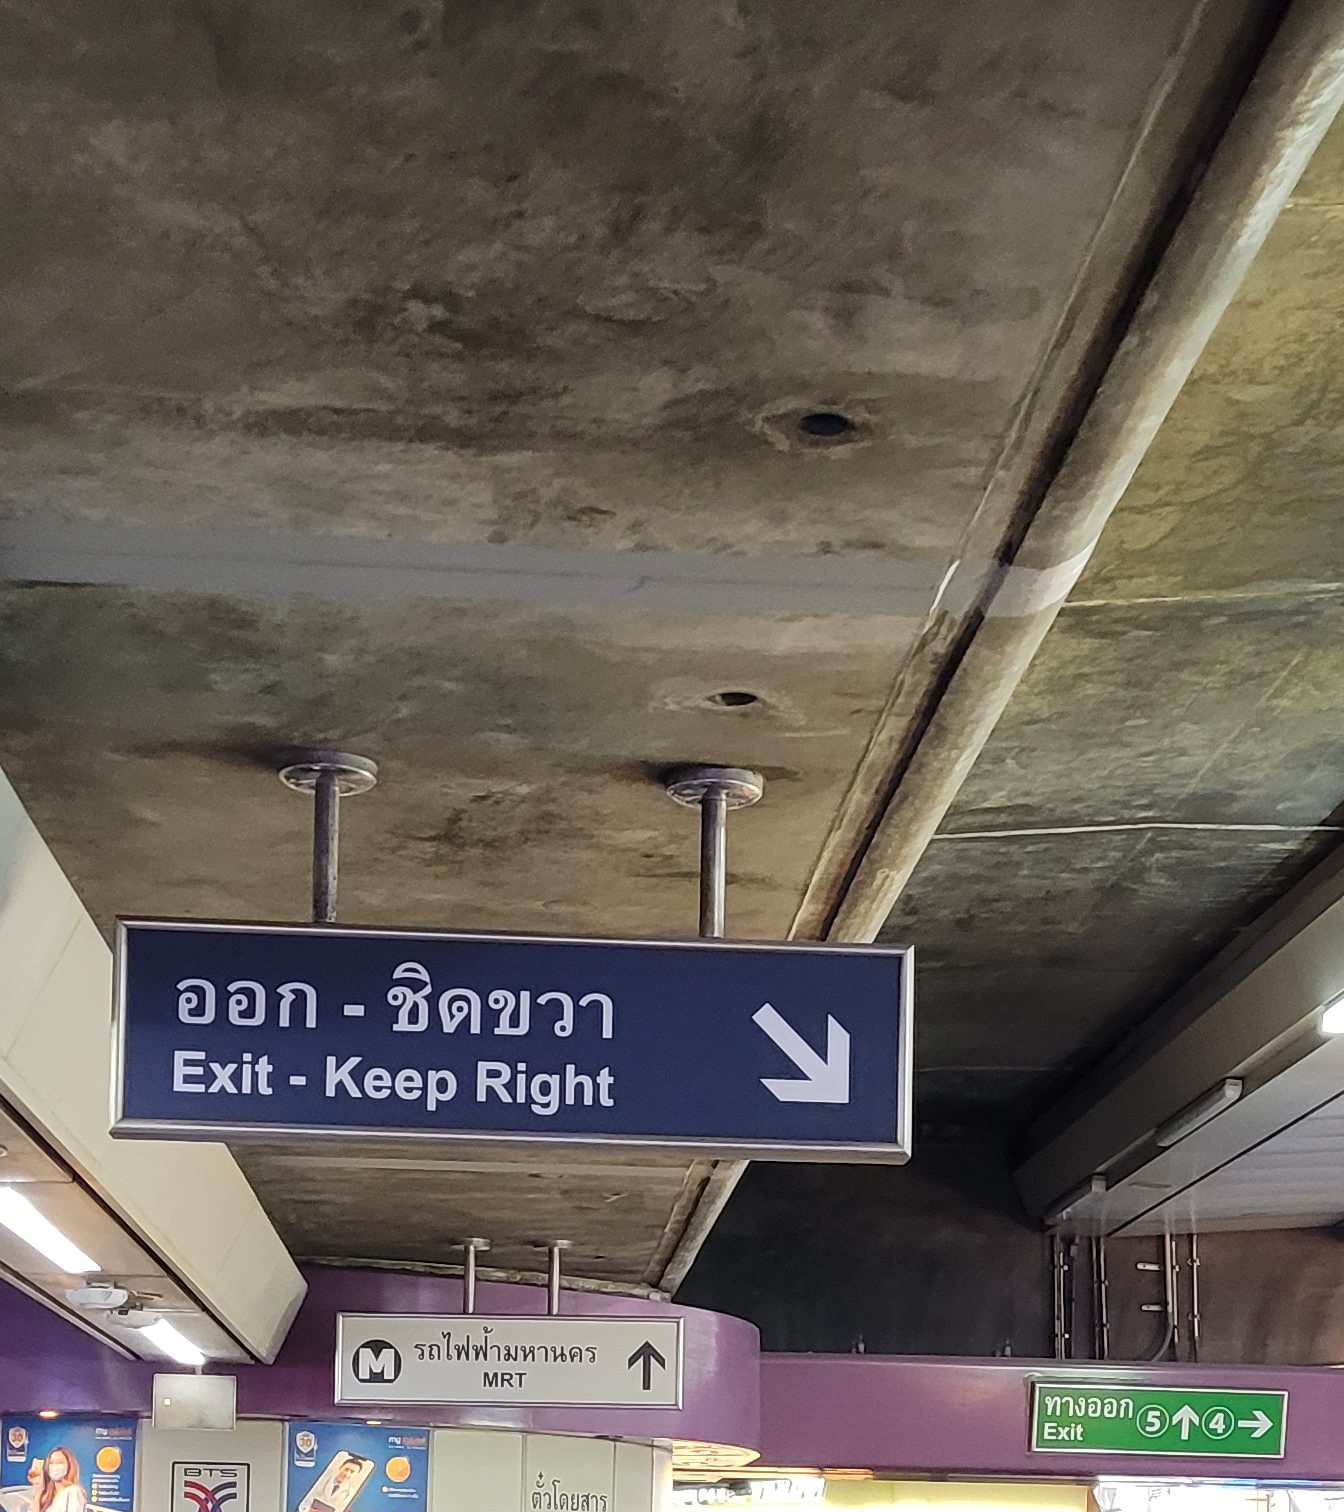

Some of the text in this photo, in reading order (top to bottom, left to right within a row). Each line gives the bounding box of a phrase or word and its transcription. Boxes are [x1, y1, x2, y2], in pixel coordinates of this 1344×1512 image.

[175, 975, 318, 1029] ออก
[386, 961, 615, 1040] ชิดขวา
[171, 1051, 274, 1096] Exit
[325, 1055, 459, 1111] Keep
[475, 1059, 616, 1117] Right
[413, 1325, 598, 1364] รถไฟฟ้ามหานคร
[482, 1371, 528, 1389] MRT
[1043, 1423, 1084, 1441] Exit
[1044, 1394, 1226, 1434] ทางออก 5 4
[183, 1467, 239, 1478] BTS
[531, 1471, 608, 1512] ตั๋วโดยสาร
